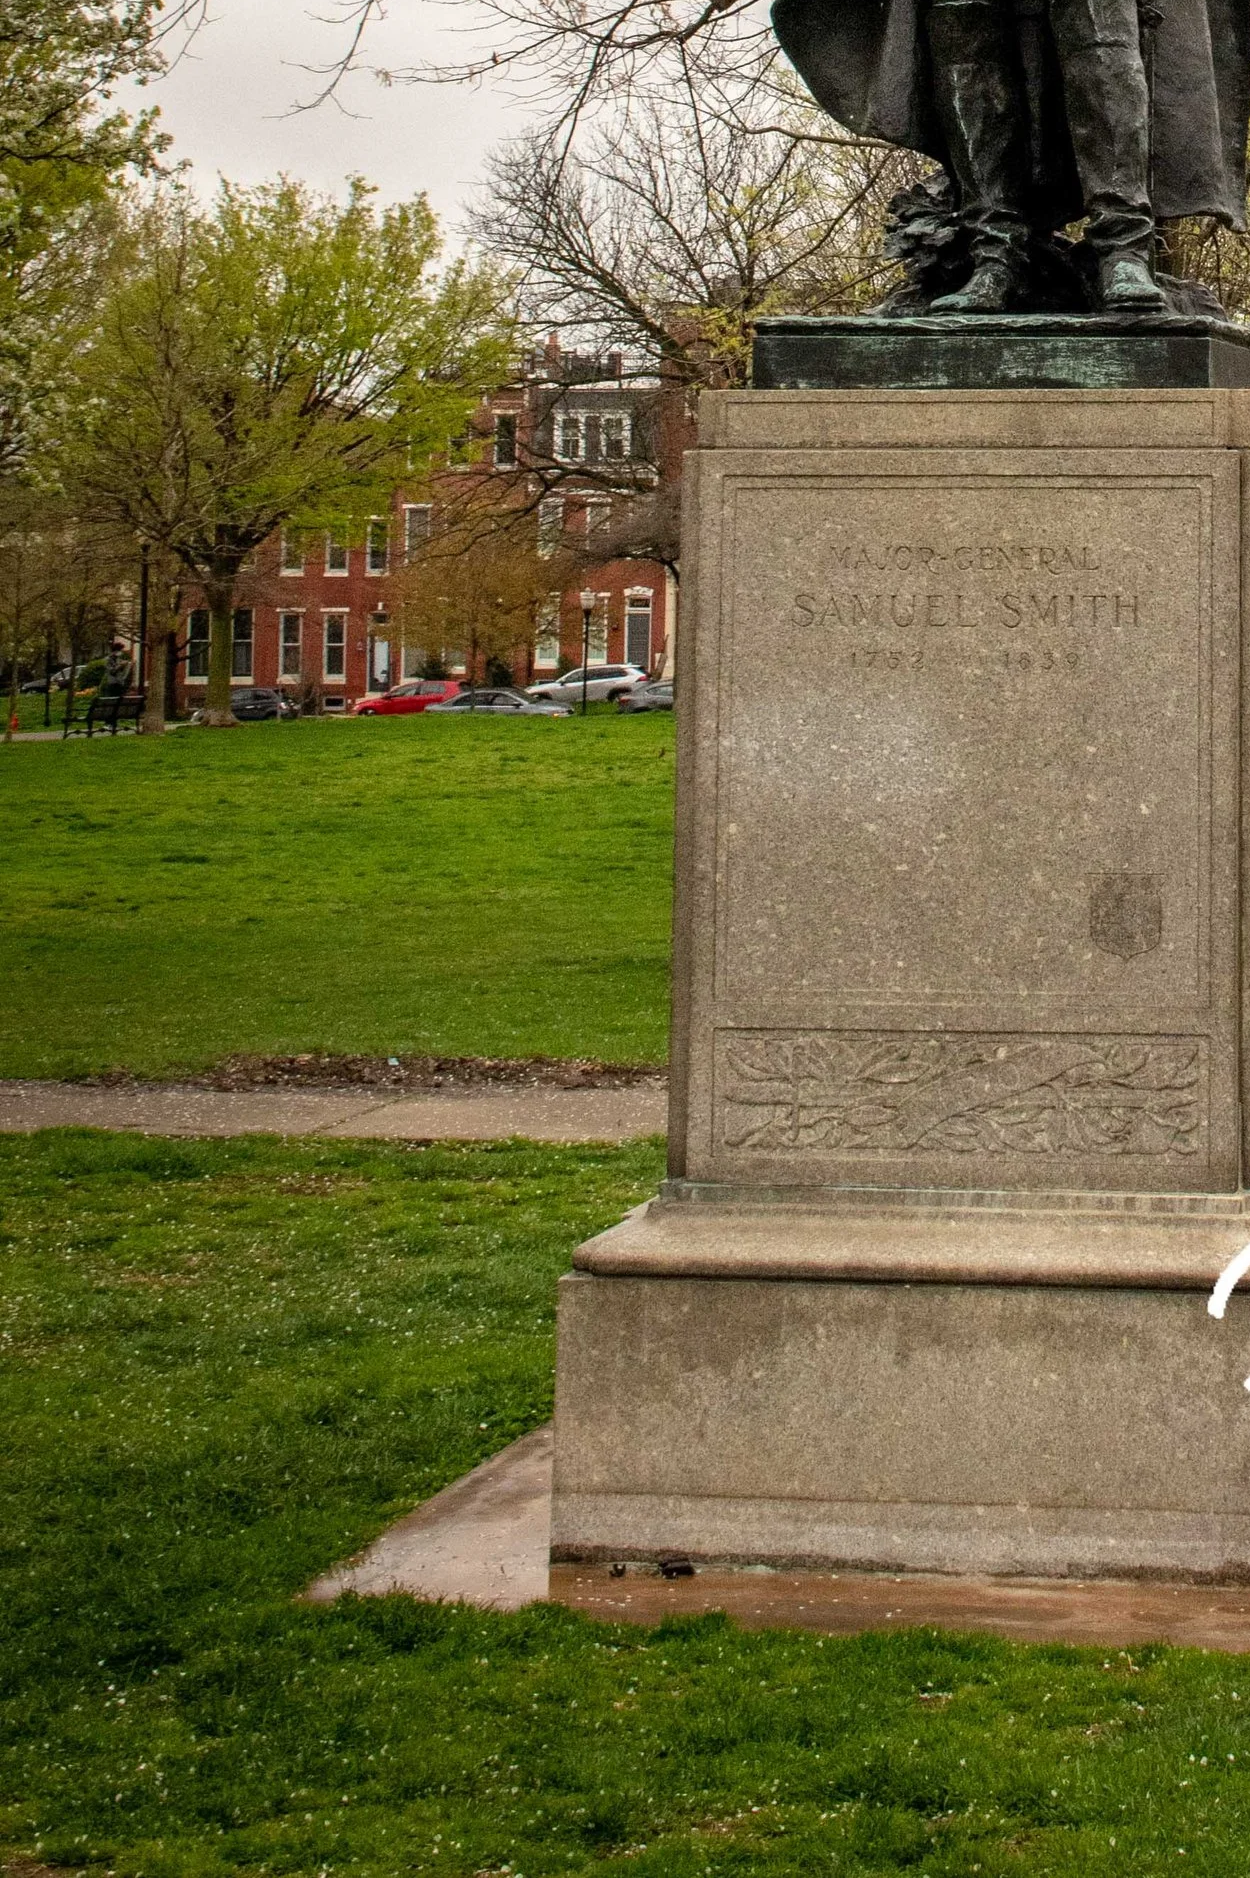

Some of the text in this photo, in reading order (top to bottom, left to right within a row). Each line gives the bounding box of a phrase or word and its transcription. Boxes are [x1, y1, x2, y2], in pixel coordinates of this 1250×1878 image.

[829, 546, 1101, 575] MAJOR-GENERAL
[791, 593, 1140, 629] SAMUEL SMITH
[850, 650, 1081, 671] 1752 1839
